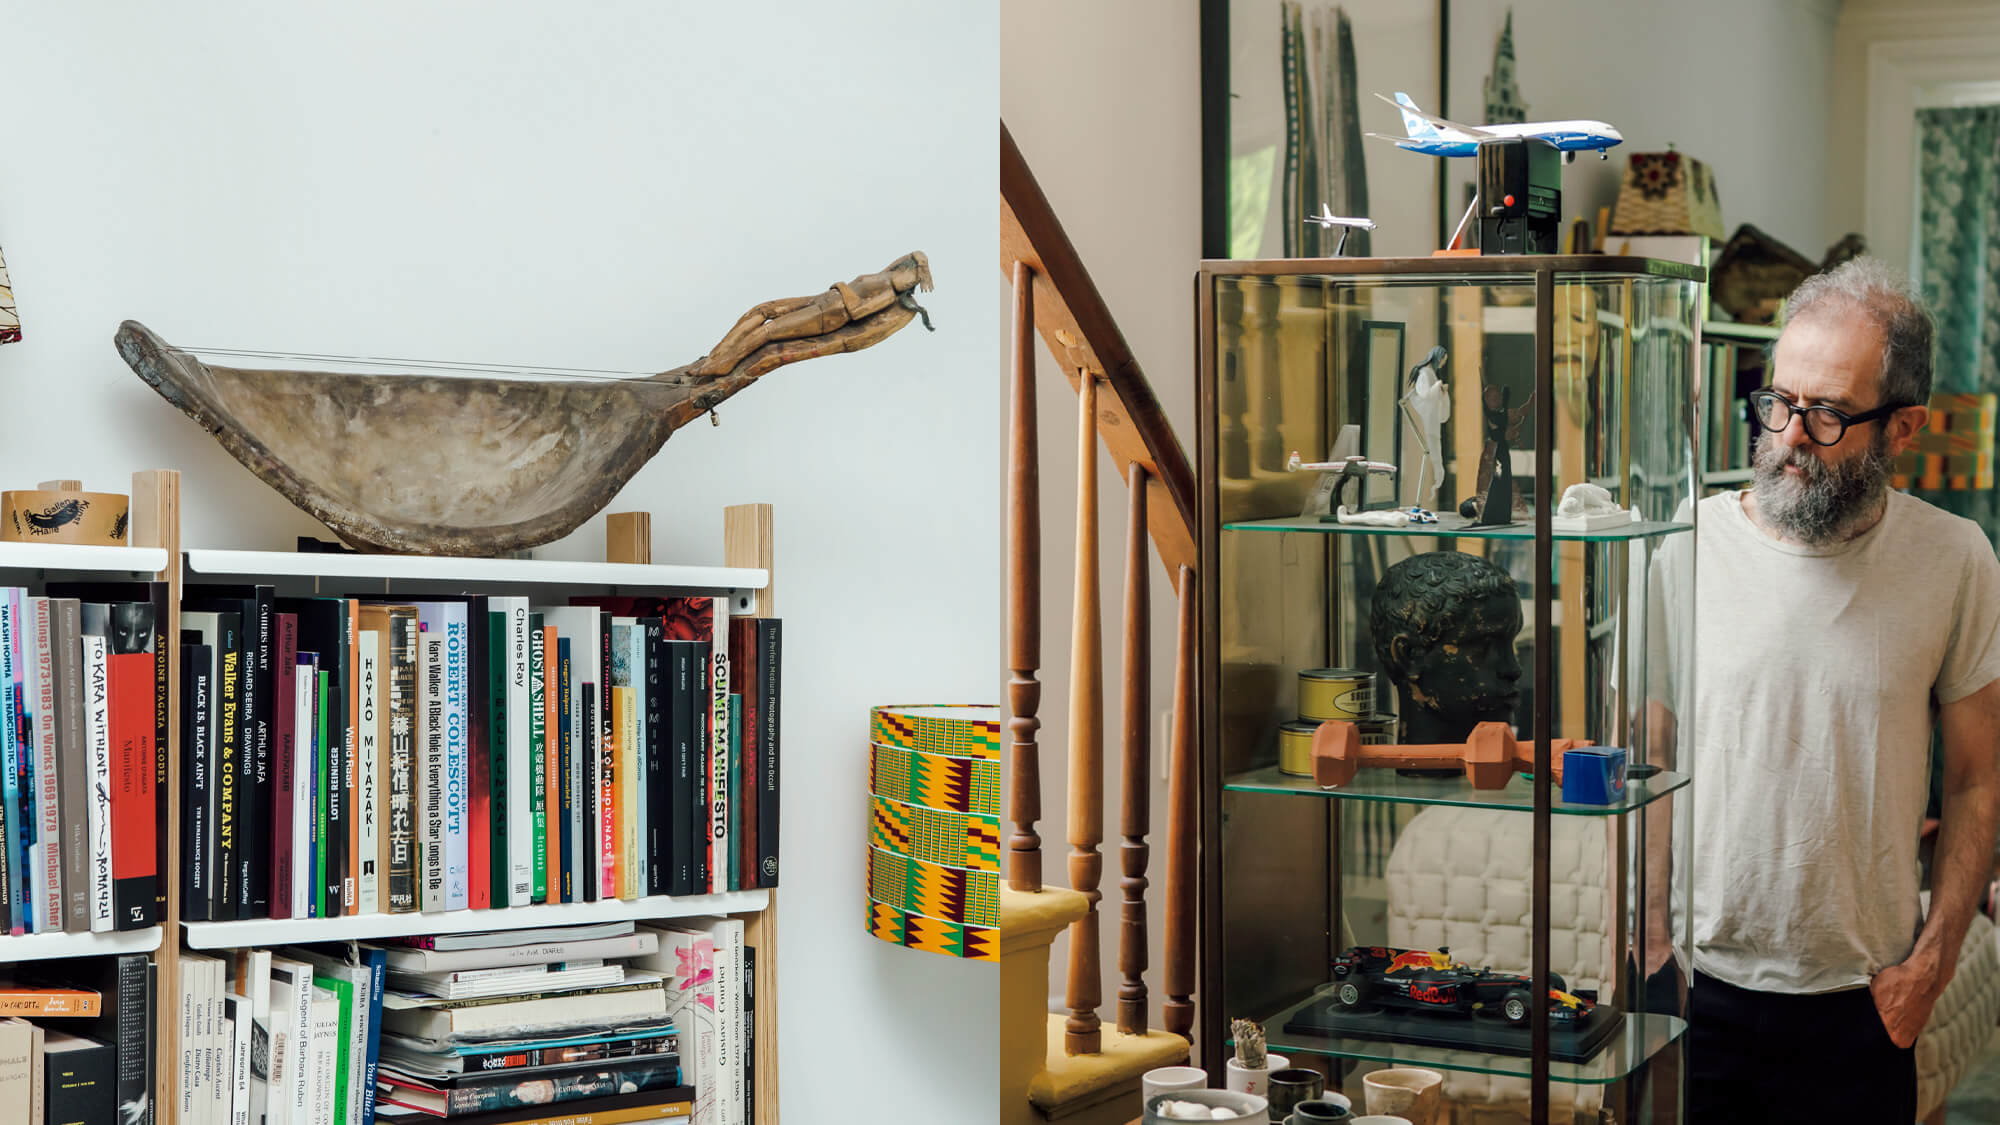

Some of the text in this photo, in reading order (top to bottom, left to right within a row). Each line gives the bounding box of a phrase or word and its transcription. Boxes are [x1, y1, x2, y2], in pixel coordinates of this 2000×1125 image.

[23, 509, 37, 536] Sankt
[44, 498, 70, 516] Gallen
[74, 500, 90, 526] Kunst
[37, 527, 60, 536] Halle
[37, 600, 48, 649] Writings
[94, 638, 104, 659] TO
[429, 640, 441, 662] Kara
[515, 608, 524, 688] Charles Ray
[40, 652, 50, 710] 1973-1983
[284, 656, 292, 676] Jafa
[429, 664, 441, 697] Walker
[92, 663, 105, 704] KARA
[532, 630, 544, 738] GHOST SHELL
[6, 703, 15, 763] NARCISSISTIC
[42, 715, 53, 730] On
[196, 711, 205, 723] IS,
[429, 707, 441, 732] Black
[447, 622, 460, 834] ROBERT COLESCOTT
[767, 697, 776, 741] Photography
[43, 733, 54, 770] Works
[221, 652, 237, 849] Walker Evans & COMPANY
[244, 727, 252, 775] DRAWINGS
[257, 721, 266, 783] ARTHUR JAFA
[346, 726, 355, 788] Walid Raad
[429, 733, 441, 752] Hole
[429, 754, 441, 763] Is
[123, 741, 133, 792] Manifesto
[196, 763, 204, 790] AIN'T
[365, 736, 373, 837] MIYAZAKI
[427, 764, 442, 811] Everything
[715, 729, 725, 839] MANIFESTO
[44, 774, 56, 832] 1969-1979
[330, 793, 338, 820] LOTTE
[429, 819, 442, 839] Star
[47, 842, 59, 889] Michael
[427, 841, 442, 867] Longs
[96, 857, 109, 919] ROMA 424
[429, 879, 442, 889] Be
[48, 893, 59, 926] Asher
[718, 966, 727, 1066] Gustave Courbet
[297, 975, 310, 1108] The Legend of Barbara Rubin
[204, 1048, 212, 1081] Heliotrope
[214, 1048, 223, 1076] Clayton's
[367, 1062, 376, 1086] Your
[364, 1089, 373, 1117] Blues
